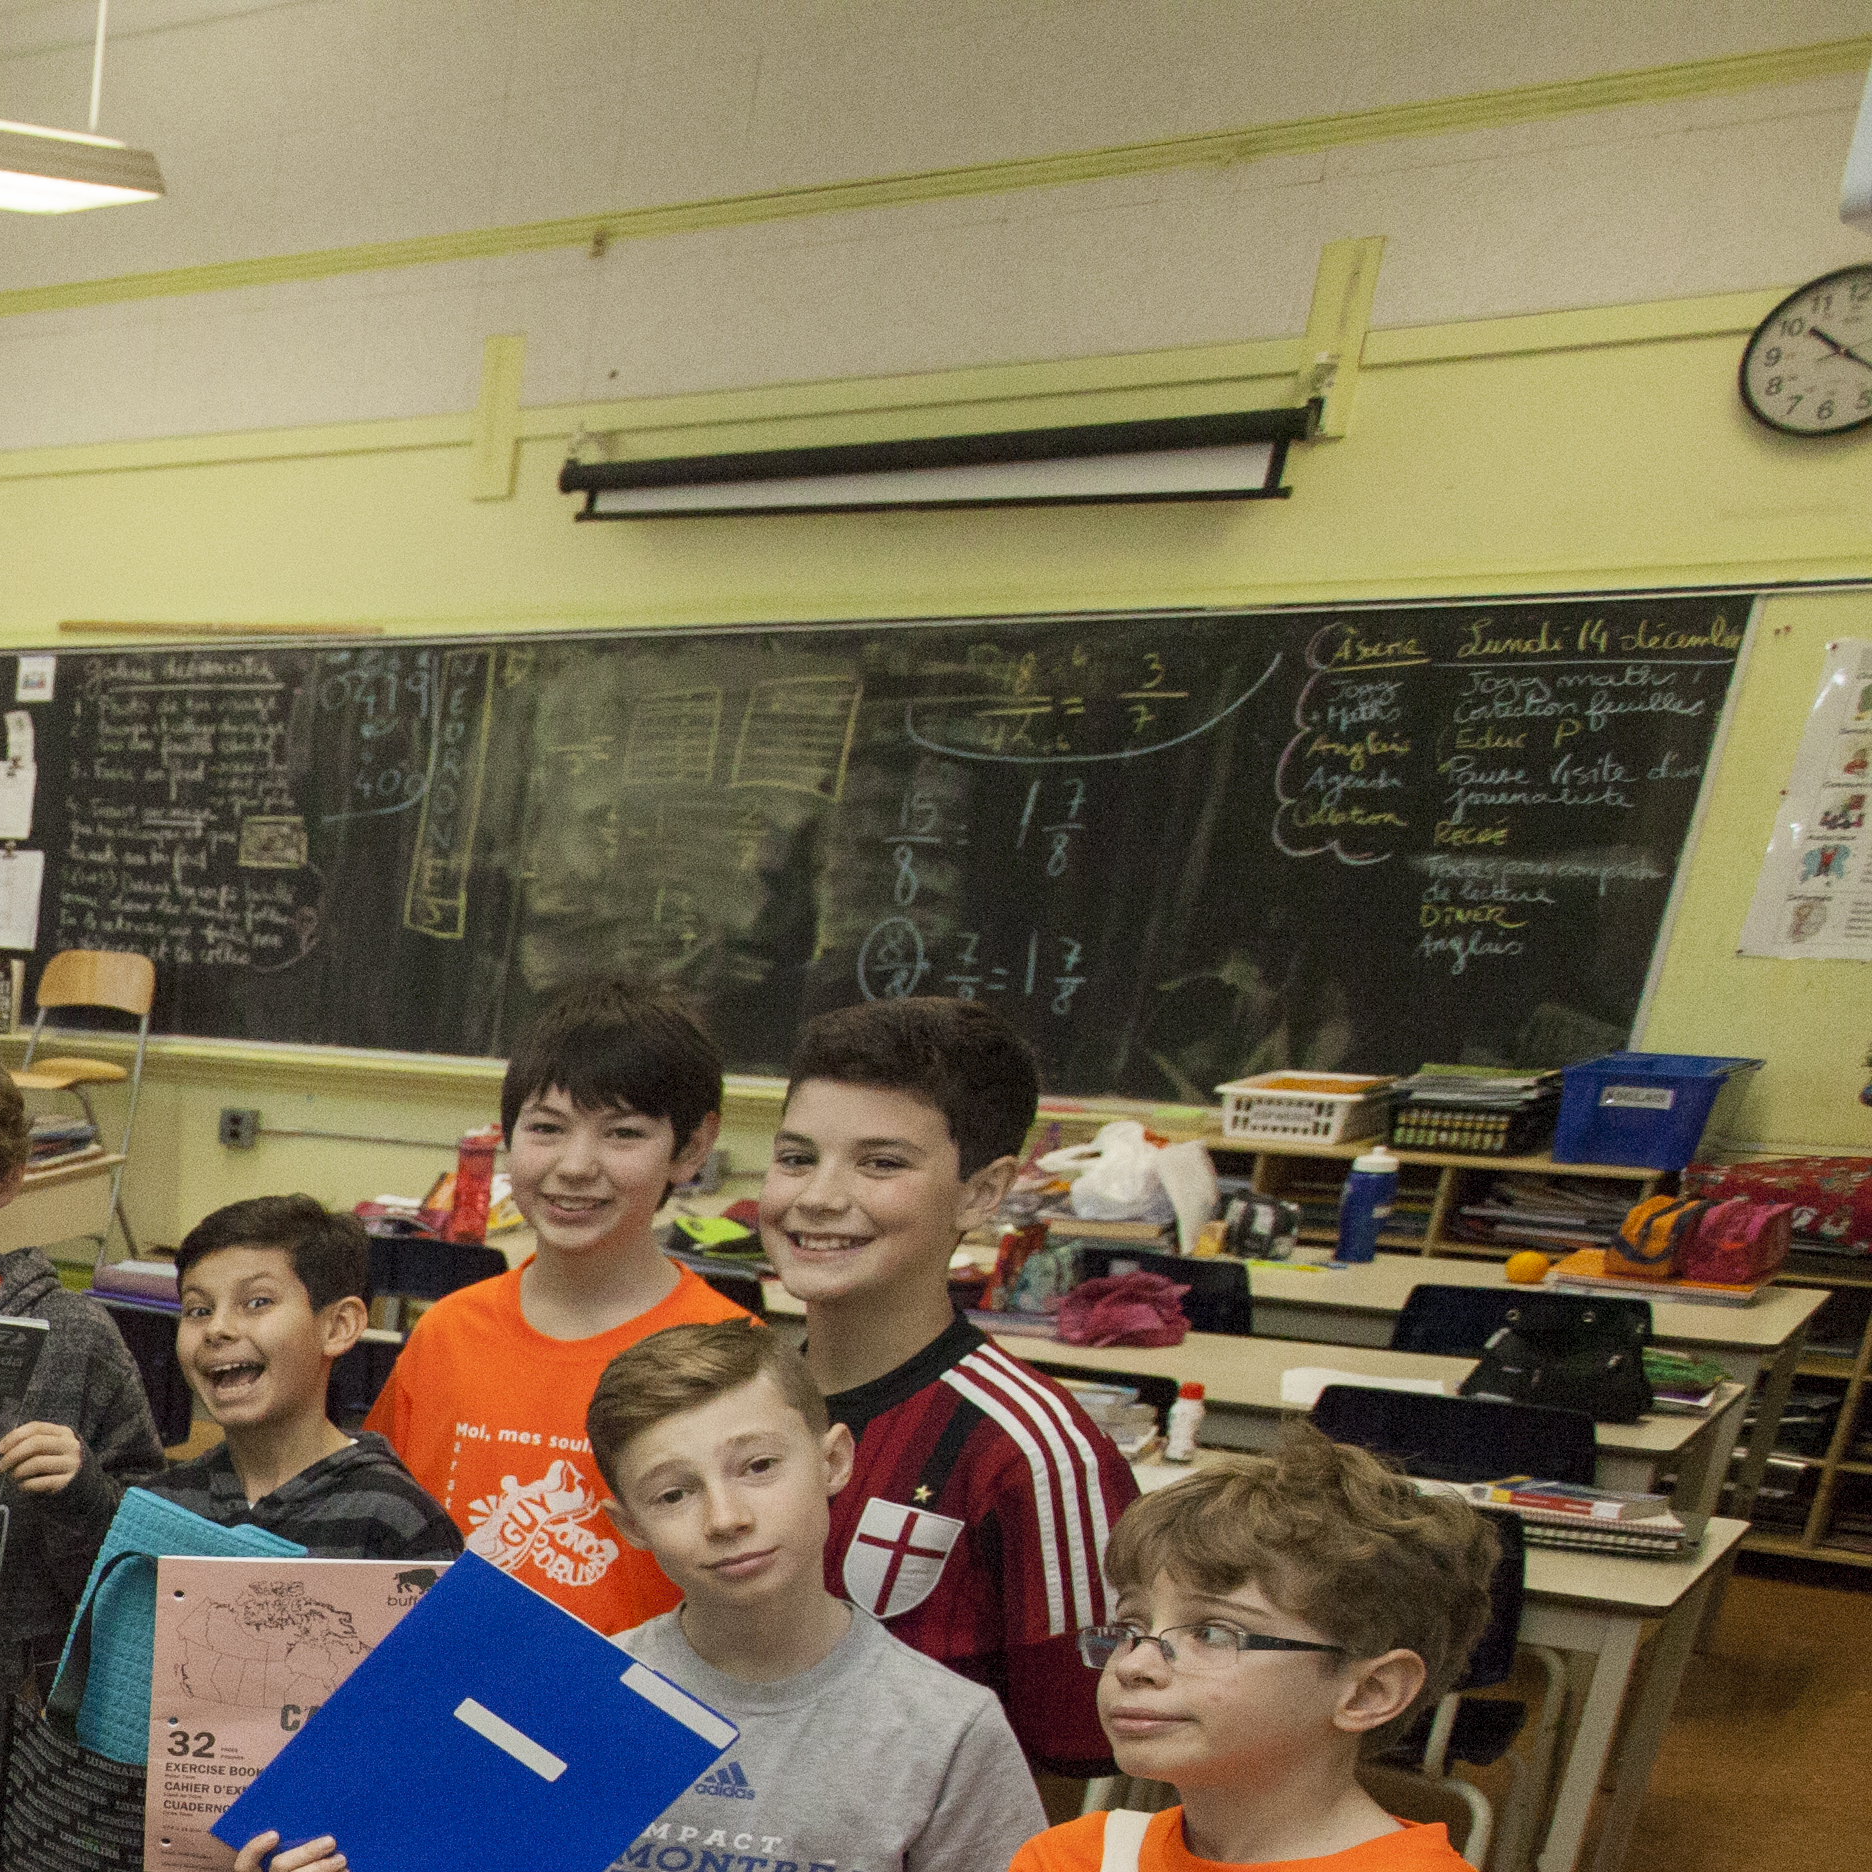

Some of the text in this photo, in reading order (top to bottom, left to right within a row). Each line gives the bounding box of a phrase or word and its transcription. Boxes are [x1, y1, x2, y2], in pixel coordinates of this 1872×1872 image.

[1779, 317, 1806, 337] 10
[1764, 346, 1783, 368] 9
[1765, 376, 1784, 397] 8
[1785, 394, 1804, 415] 7
[1816, 399, 1836, 419] 6
[1579, 619, 1608, 653] 14
[455, 1422, 592, 1453] Moi, mes soul
[499, 1492, 553, 1547] GUY
[167, 1730, 217, 1759] 32
[165, 1762, 227, 1776] EXERCISE
[164, 1782, 211, 1794] CAHIER
[694, 1781, 756, 1801] adidas
[642, 1822, 784, 1854] MPACT
